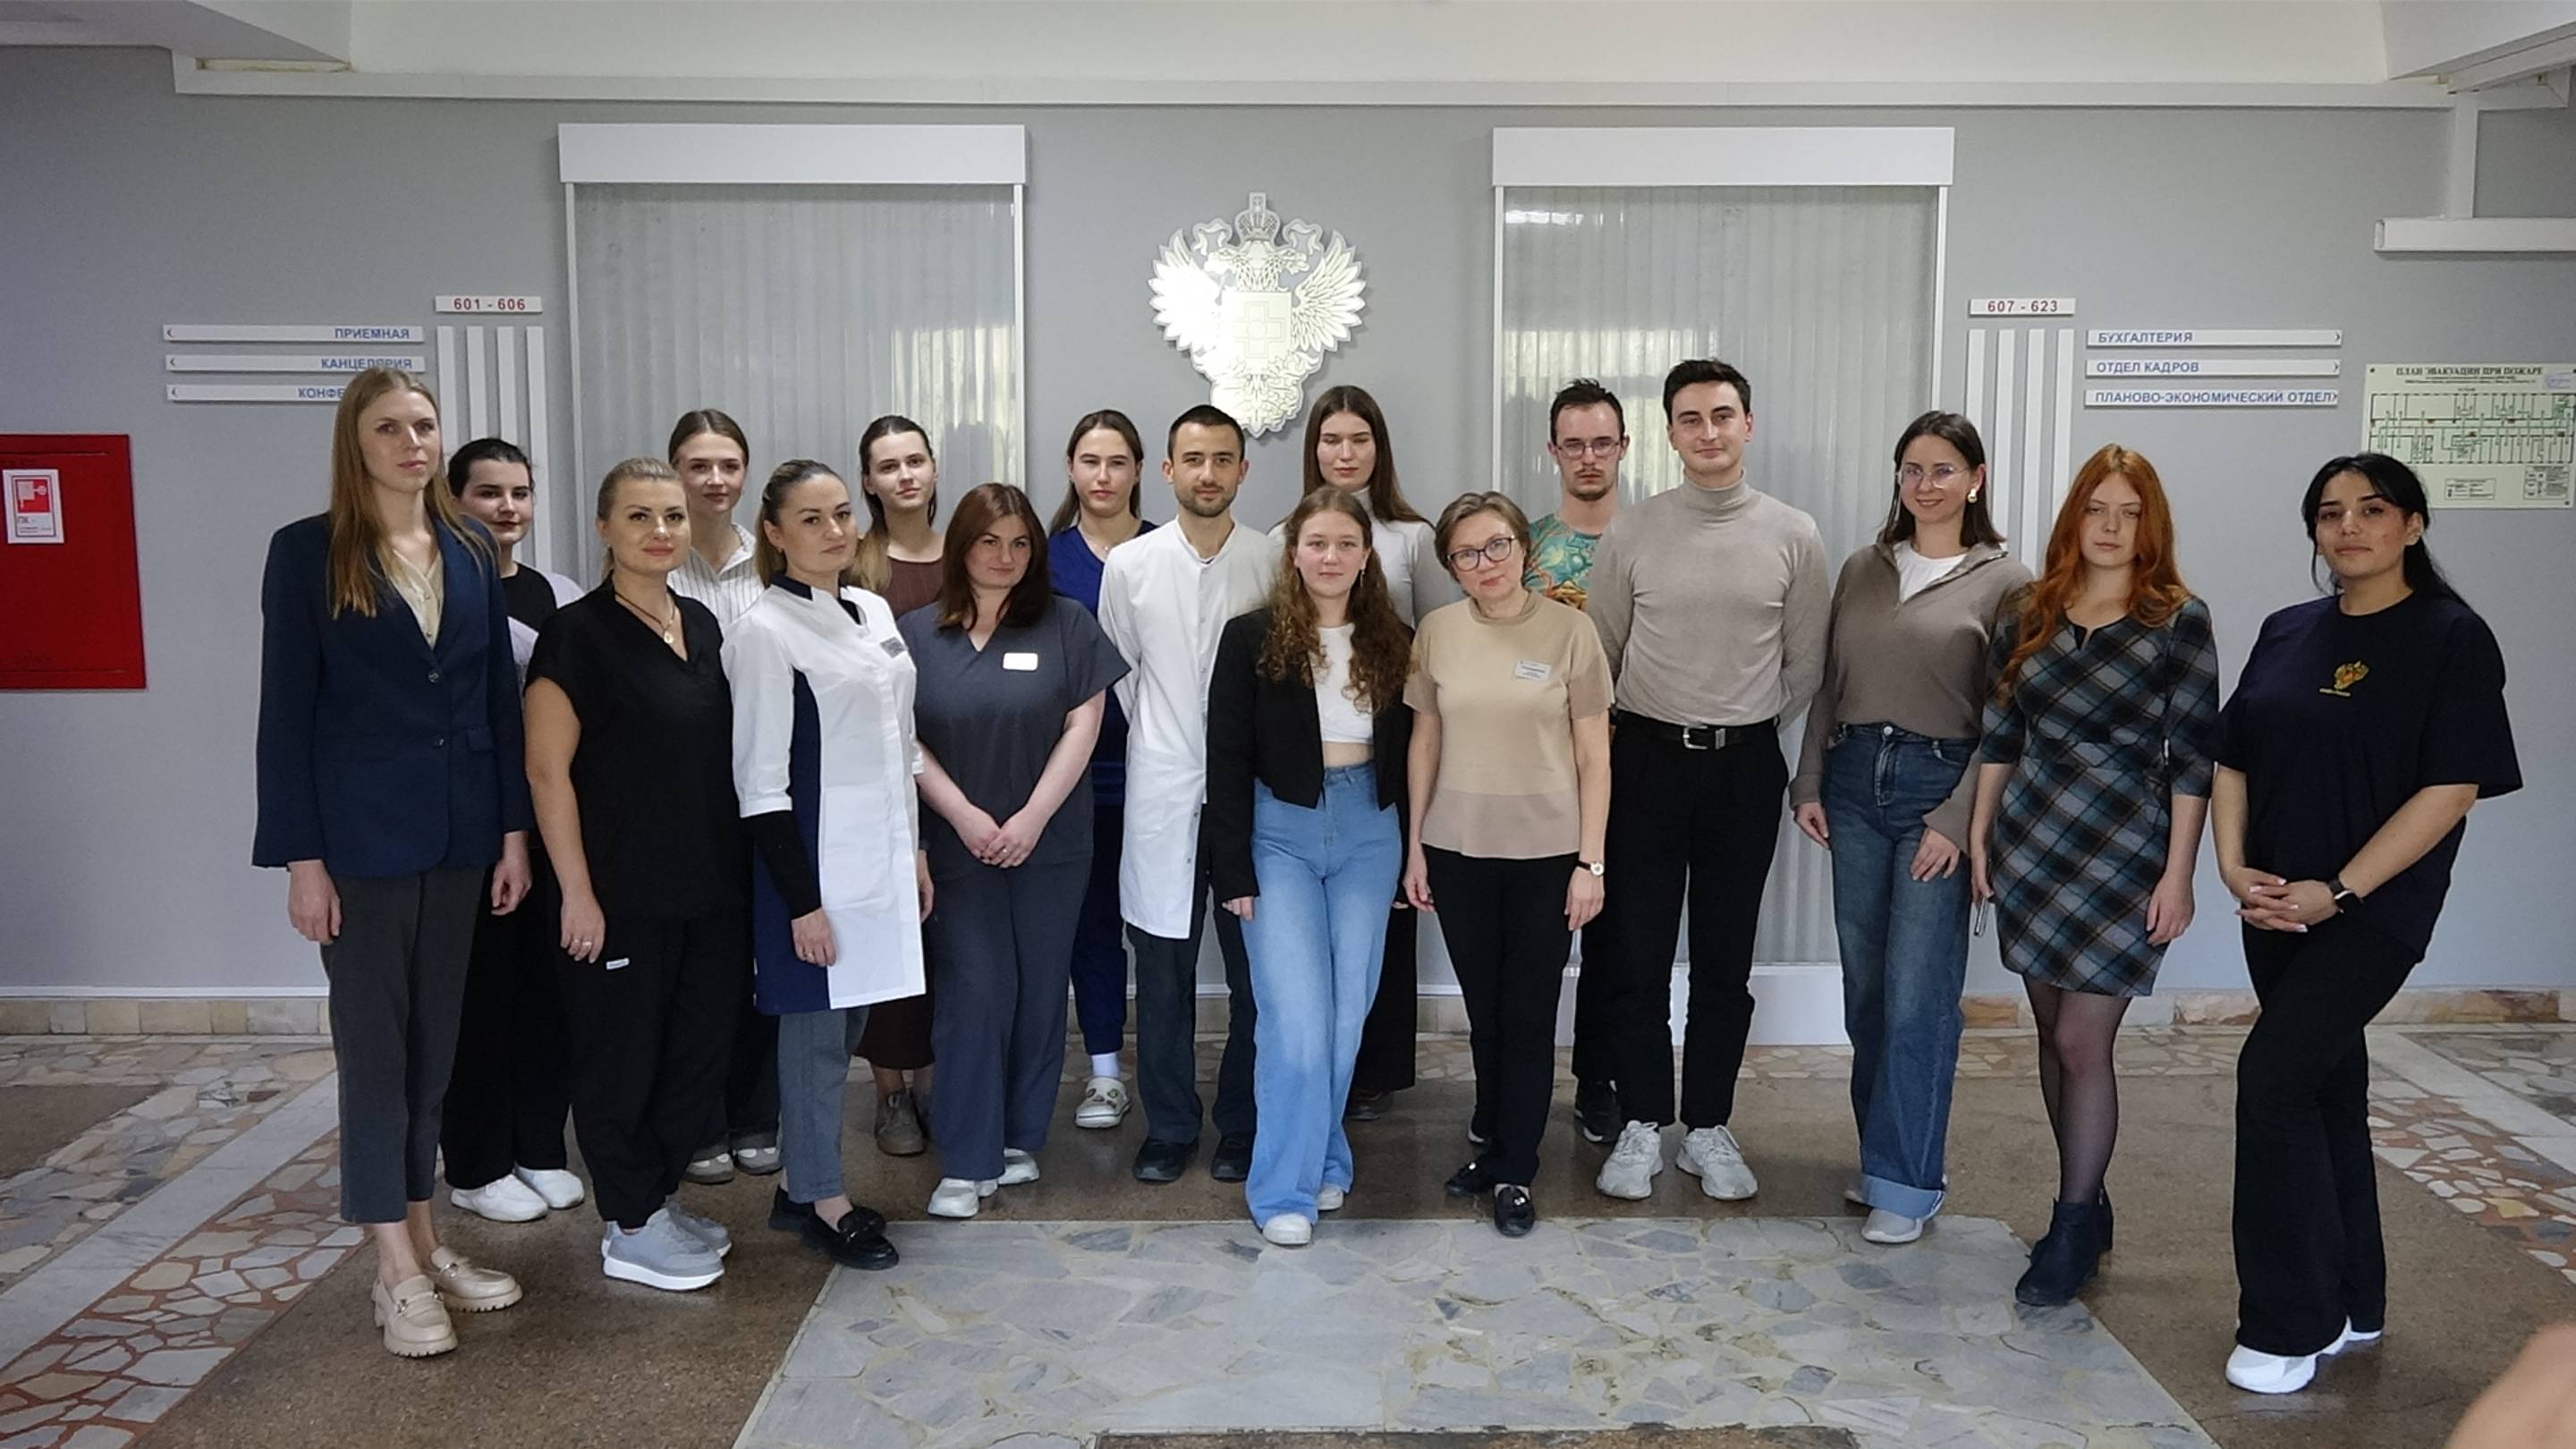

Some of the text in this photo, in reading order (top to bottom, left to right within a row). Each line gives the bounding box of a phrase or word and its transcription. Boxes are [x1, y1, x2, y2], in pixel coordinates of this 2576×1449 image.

[453, 298, 480, 310] 601
[497, 298, 526, 310] 606
[1987, 300, 2015, 312] 607
[2030, 300, 2058, 312] 623
[335, 328, 410, 339] ПРИЕМНАЯ
[2098, 332, 2193, 343] БУХГАЛТЕРИЯ
[2096, 361, 2199, 374] ОТДЕЛ КАДРОВ
[298, 387, 344, 398] КОНФЕ
[2095, 391, 2332, 403] ПЛАНОВО-ЭКОНОМИЧЕСКИЙ ОТДЕЛ
